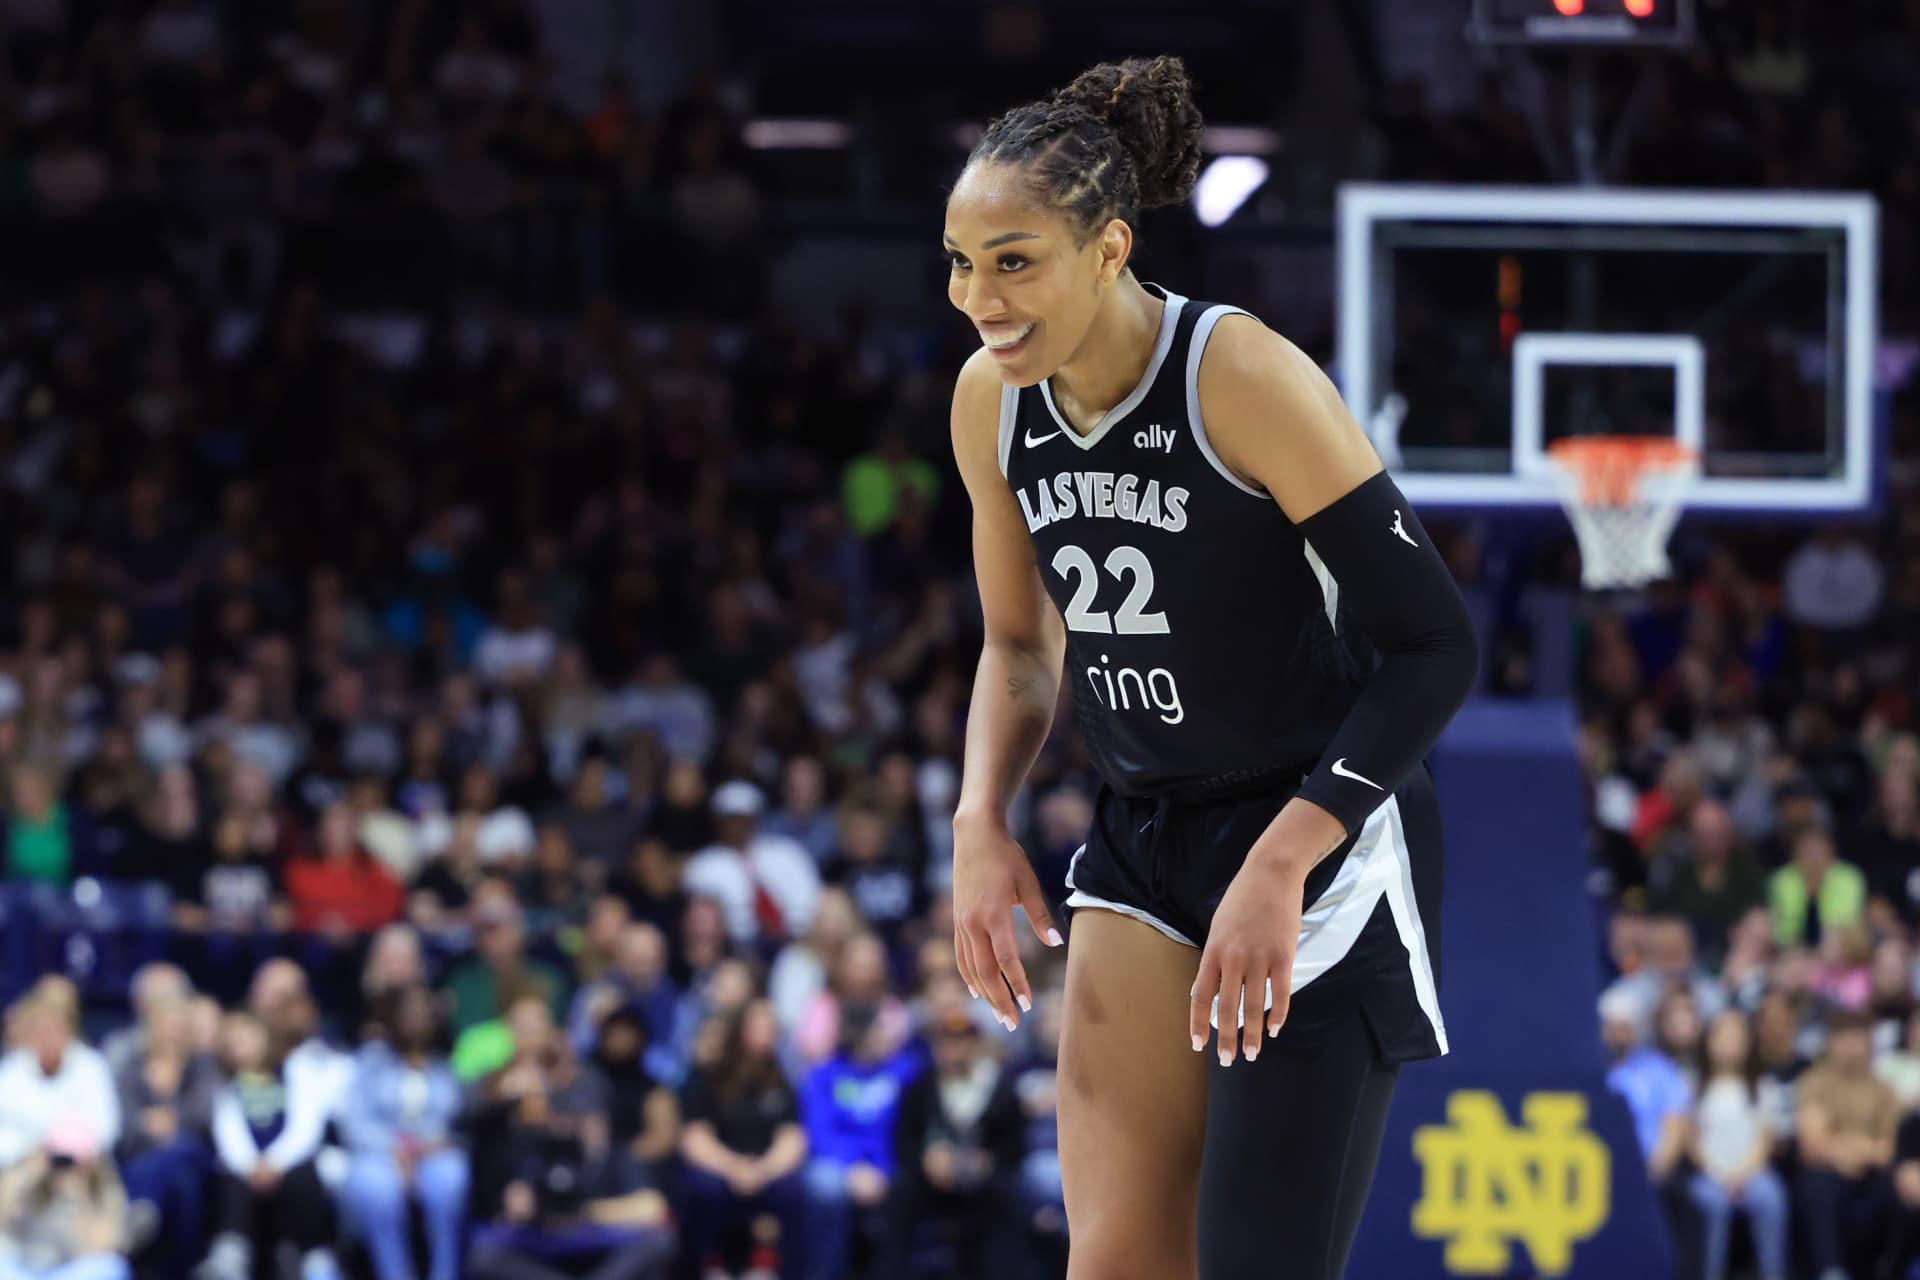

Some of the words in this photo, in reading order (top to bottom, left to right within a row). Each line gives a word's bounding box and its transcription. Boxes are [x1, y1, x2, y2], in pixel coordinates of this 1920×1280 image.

[1133, 424, 1177, 453] ally
[1051, 545, 1171, 635] 22
[1087, 654, 1184, 724] ring
